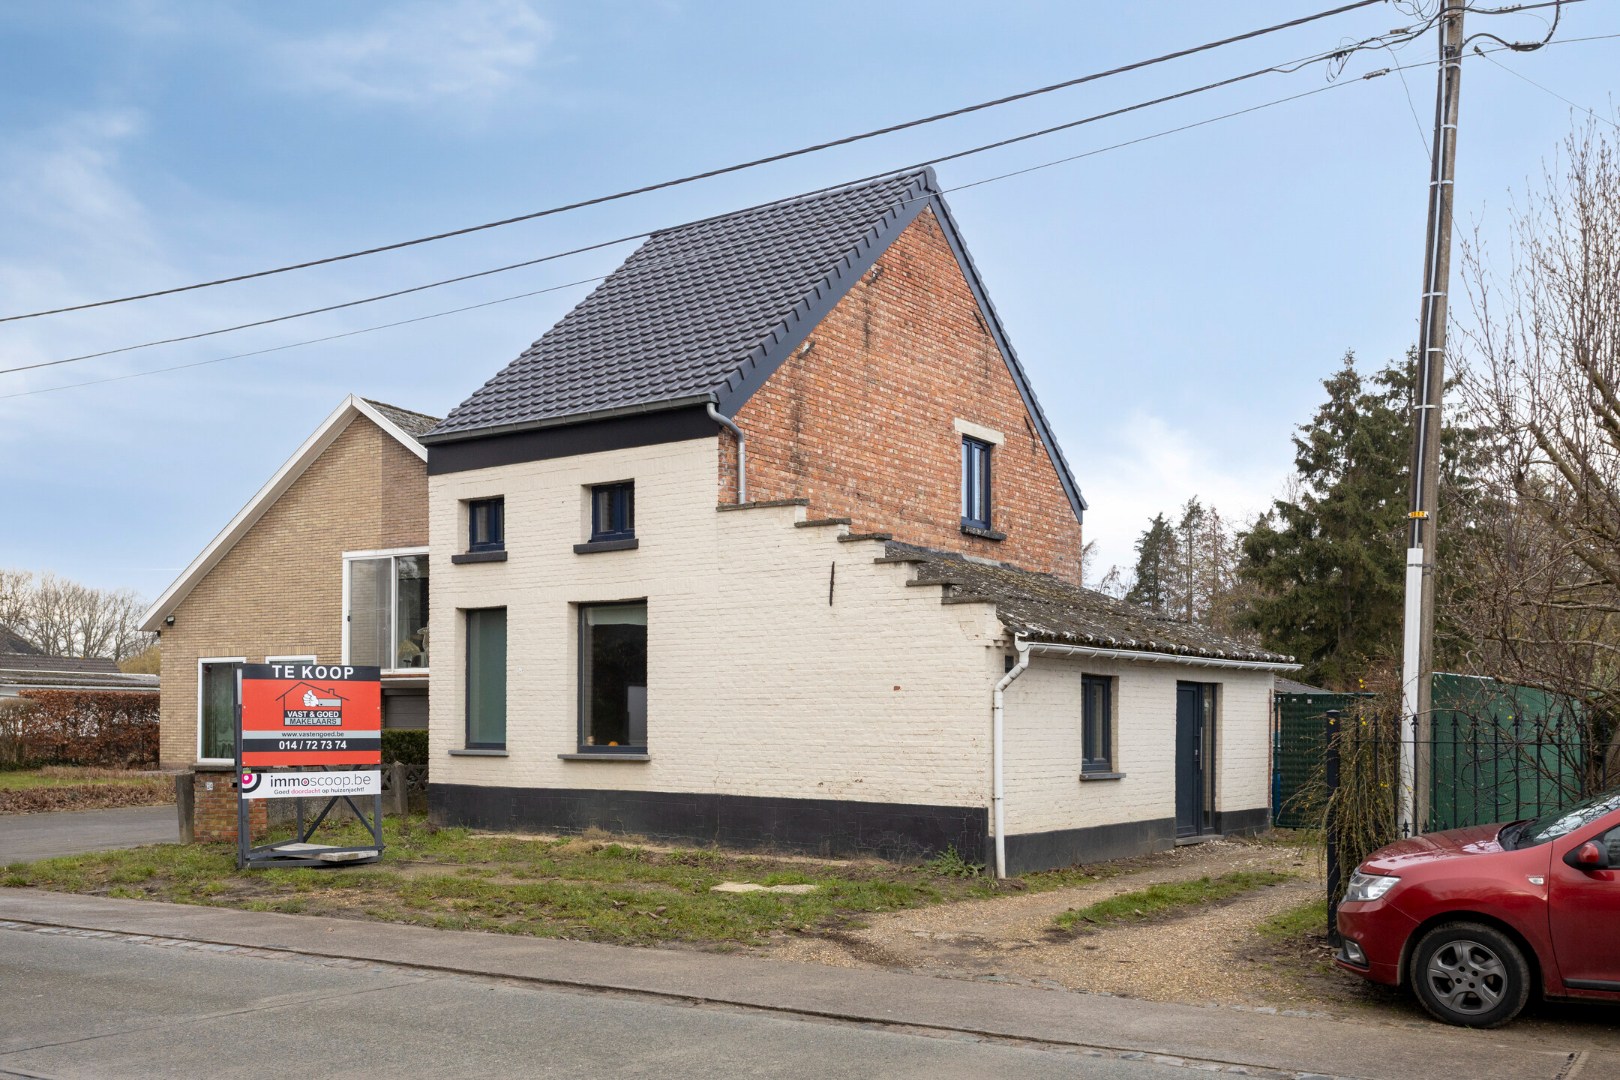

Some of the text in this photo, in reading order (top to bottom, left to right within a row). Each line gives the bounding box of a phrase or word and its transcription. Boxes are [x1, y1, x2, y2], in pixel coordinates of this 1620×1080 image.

[272, 665, 354, 680] TE KOOP
[279, 740, 297, 749] 014
[306, 740, 318, 749] 72
[320, 740, 332, 749] 73
[335, 740, 347, 749] 74
[270, 774, 371, 788] immoscoop.be
